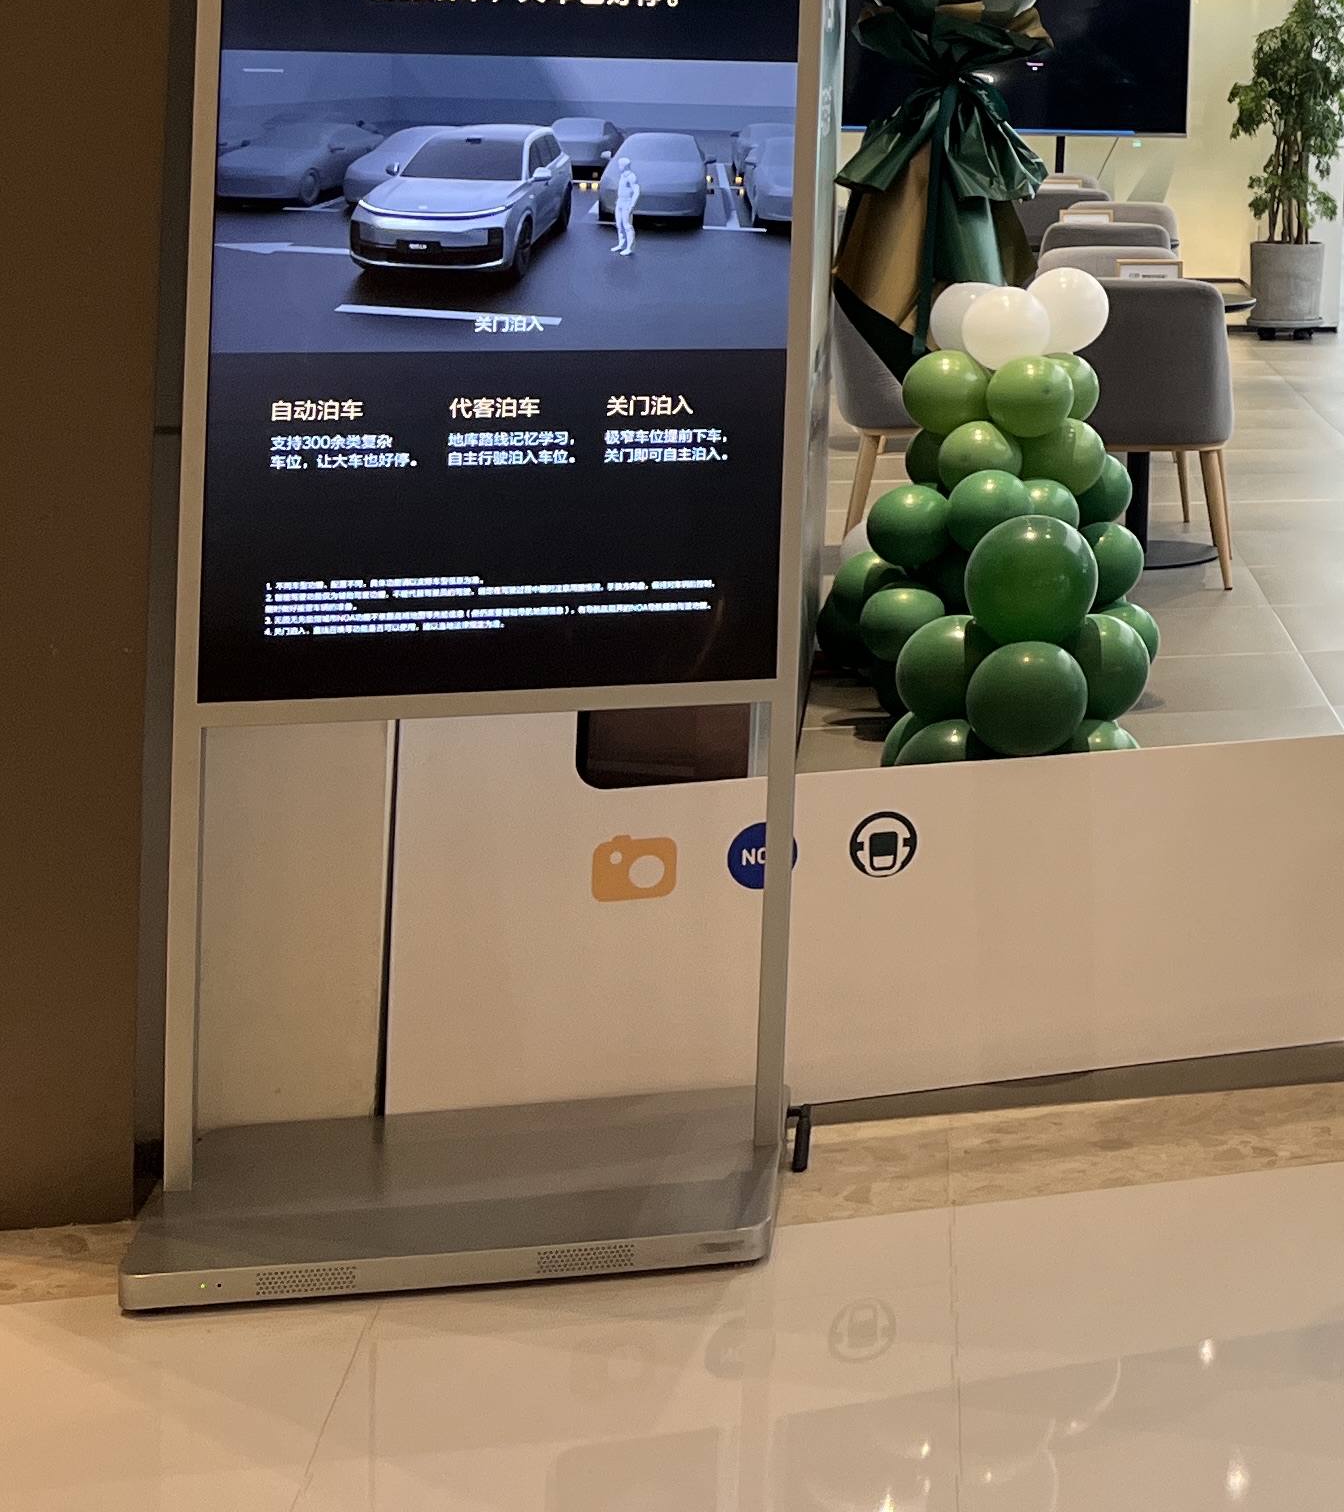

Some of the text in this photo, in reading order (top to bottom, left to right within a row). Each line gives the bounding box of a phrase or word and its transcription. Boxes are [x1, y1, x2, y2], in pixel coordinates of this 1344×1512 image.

[474, 314, 545, 334] 关门泊入
[270, 398, 364, 422] 自动泊车
[449, 396, 541, 419] 代客泊车
[606, 394, 694, 417] 关门泊入
[270, 434, 393, 451] 支持300余类复杂
[269, 453, 418, 470] 车位，让大车也好停。
[447, 450, 576, 467] 自主行驶泊入车位。
[603, 447, 728, 464] 关门即可自主泊入。
